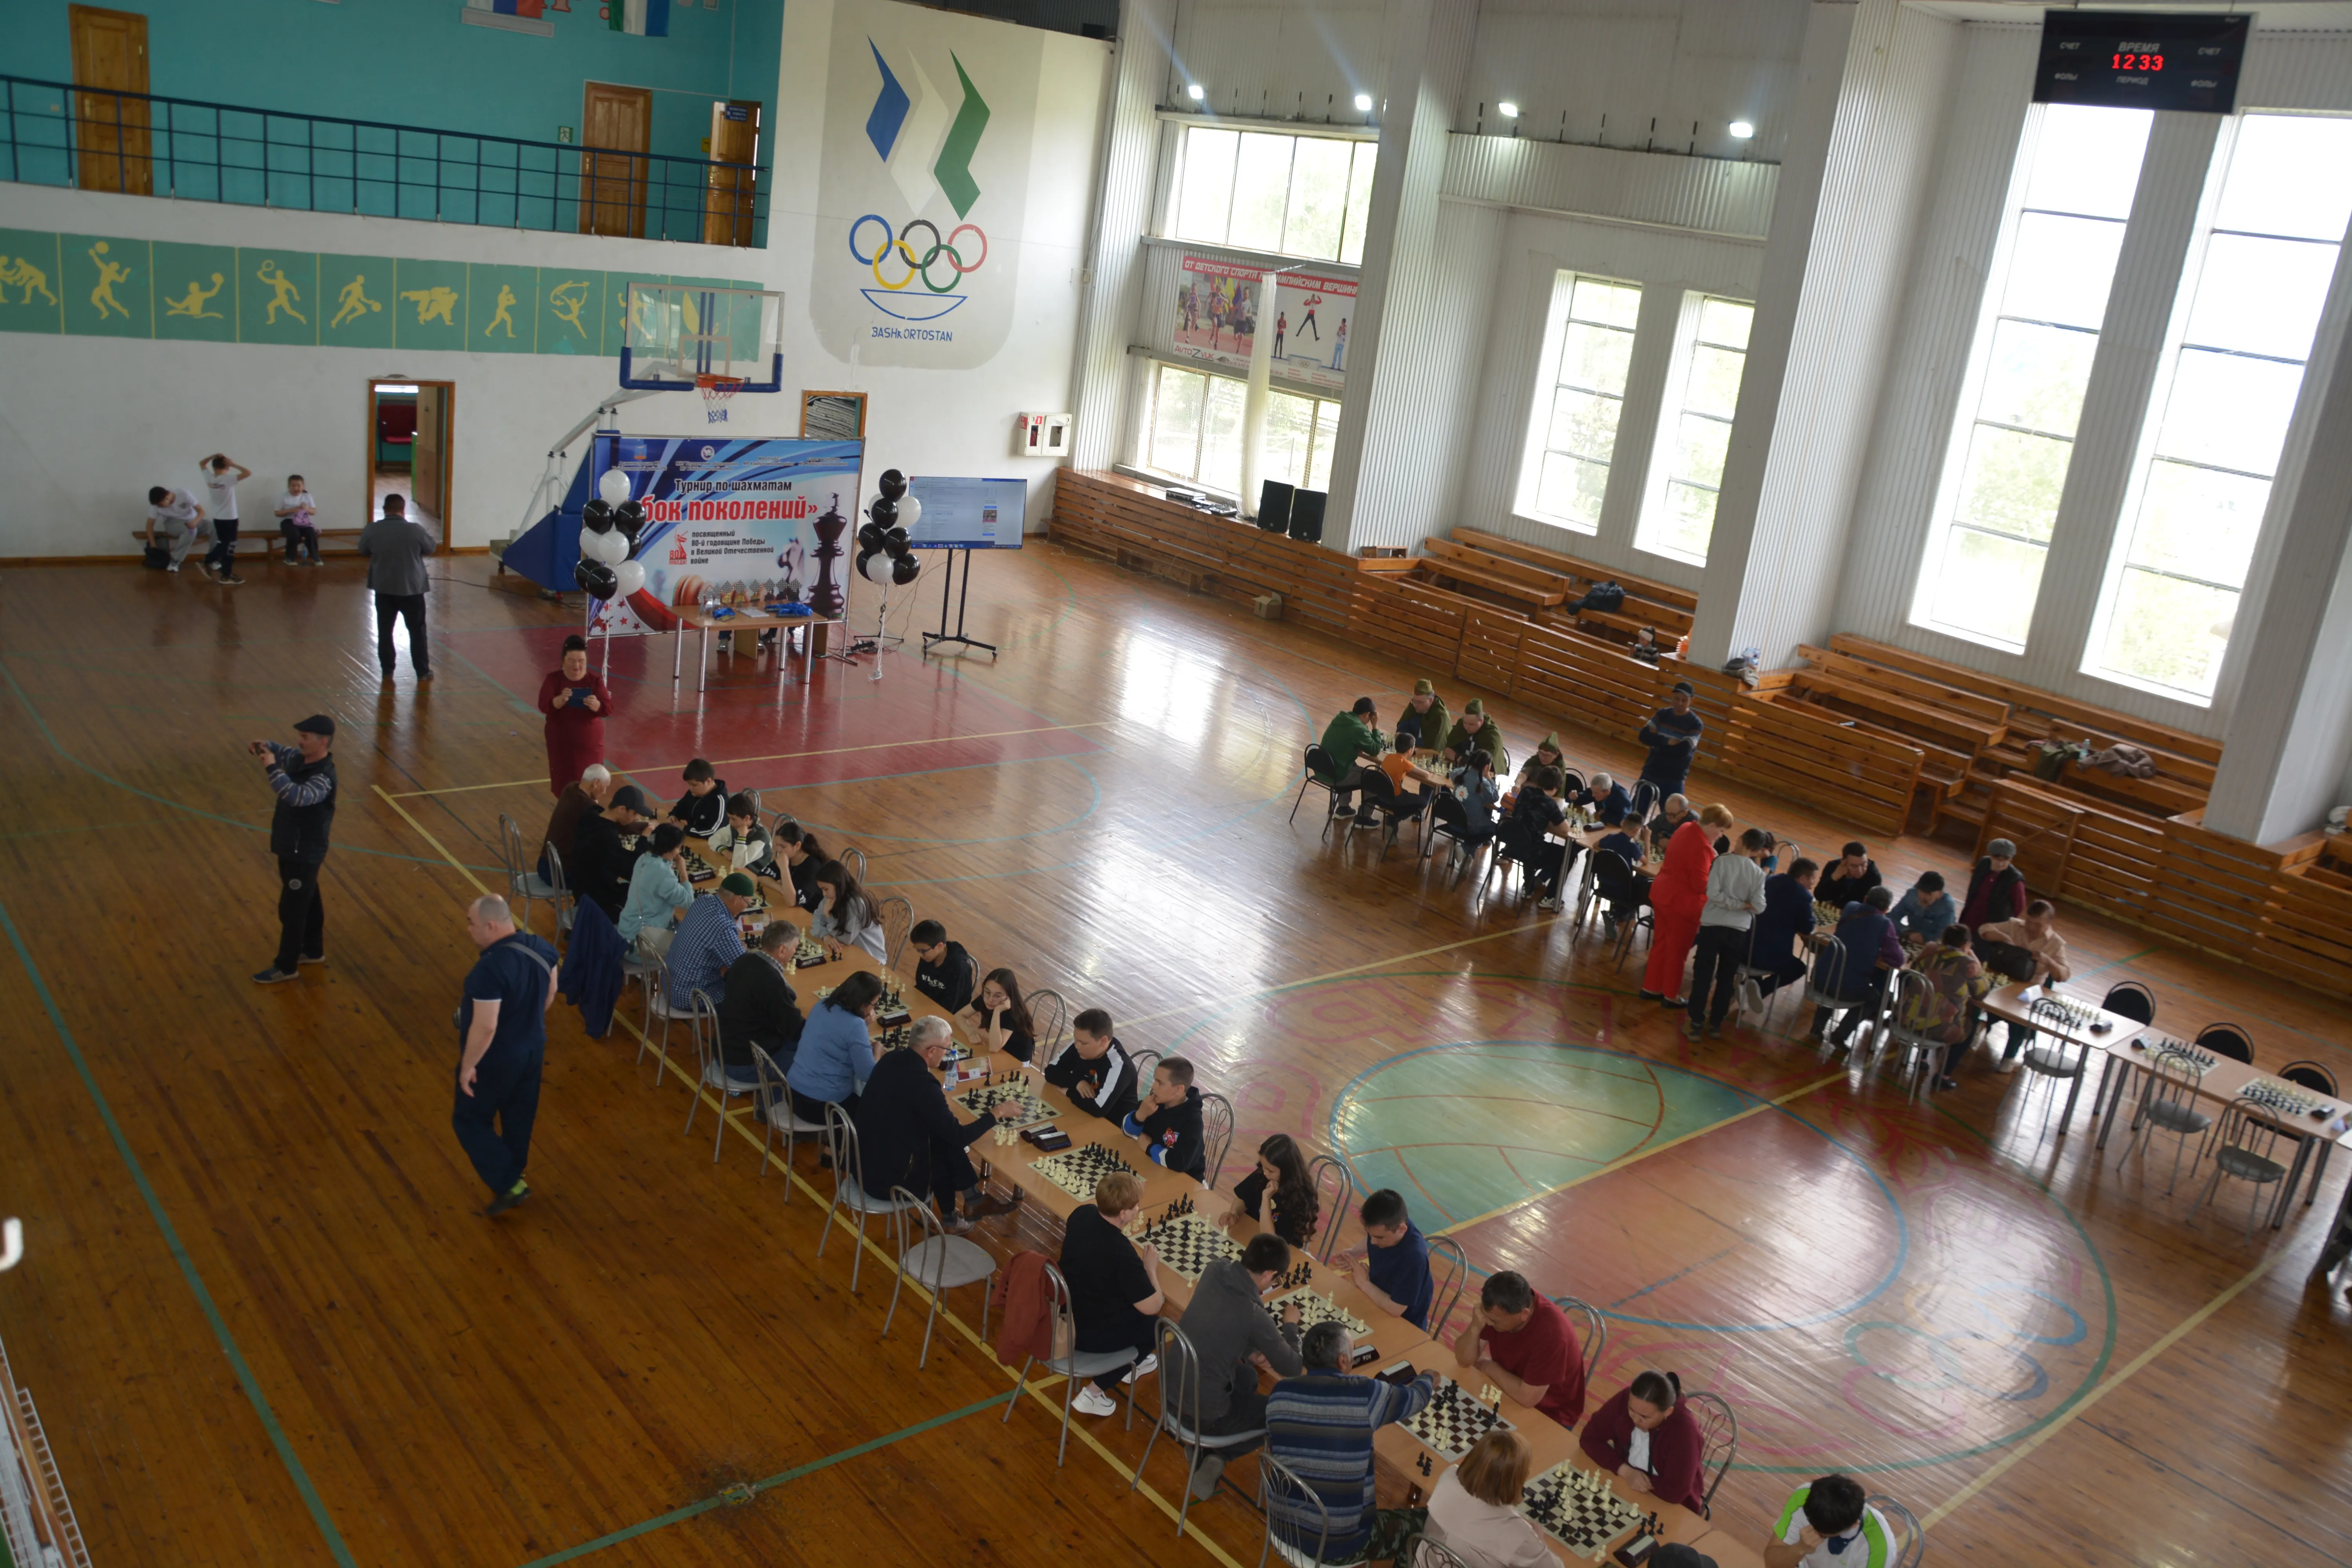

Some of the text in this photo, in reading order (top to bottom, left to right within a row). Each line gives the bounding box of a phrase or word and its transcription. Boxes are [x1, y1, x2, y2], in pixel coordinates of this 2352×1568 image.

[2060, 42, 2081, 50] СЧЕТ
[2118, 41, 2160, 53] ВРЕМЯ
[1185, 260, 1194, 269] ОТ
[1195, 262, 1229, 274] ДЕТСКОГО
[1230, 267, 1258, 279] СПОРТА
[675, 479, 792, 494] Турнир по шахматам
[688, 496, 818, 521] поколений»
